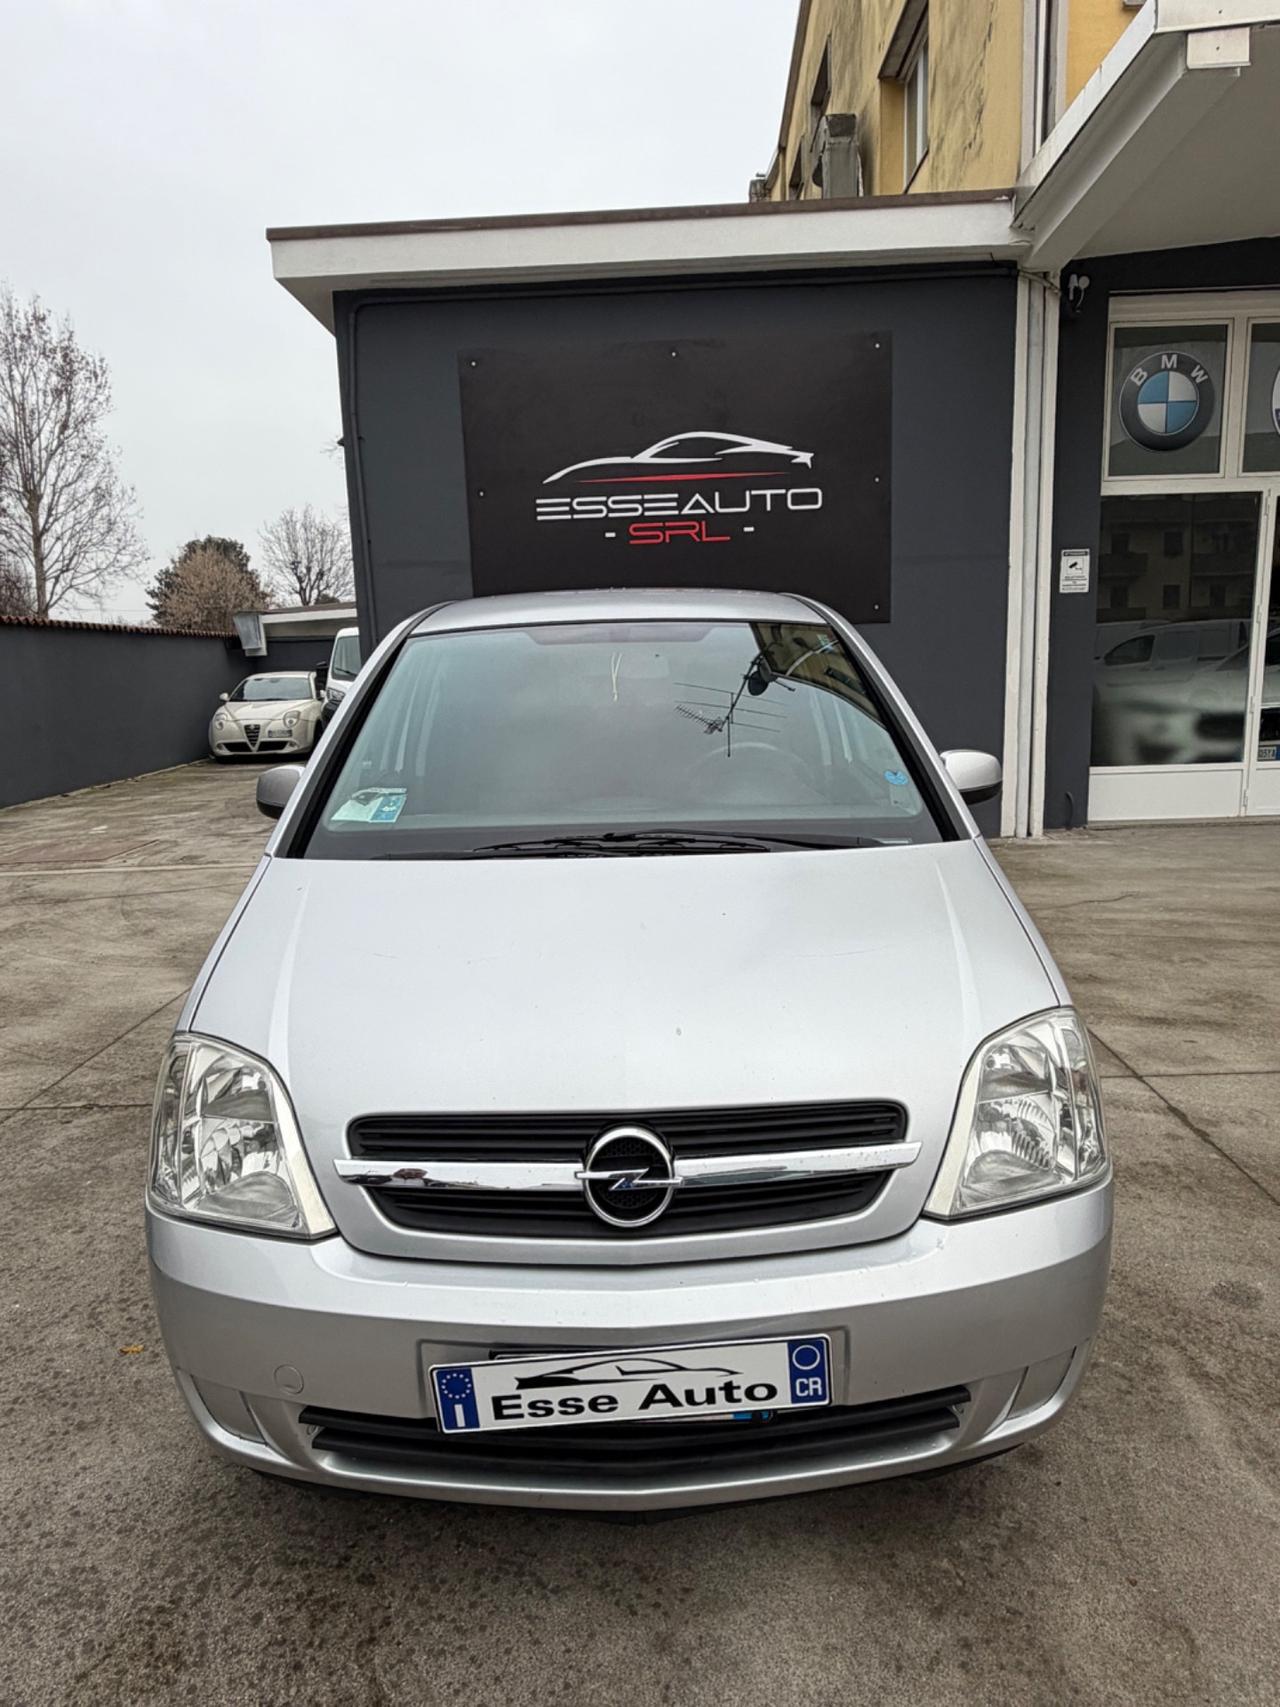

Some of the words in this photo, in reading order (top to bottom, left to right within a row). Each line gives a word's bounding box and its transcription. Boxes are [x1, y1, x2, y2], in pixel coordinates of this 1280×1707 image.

[1130, 354, 1208, 386] BMW
[536, 488, 823, 520] ESSEAUTO
[629, 520, 731, 544] SRL
[491, 1394, 619, 1420] Esse
[638, 1380, 778, 1411] Auto
[795, 1377, 822, 1397] CR
